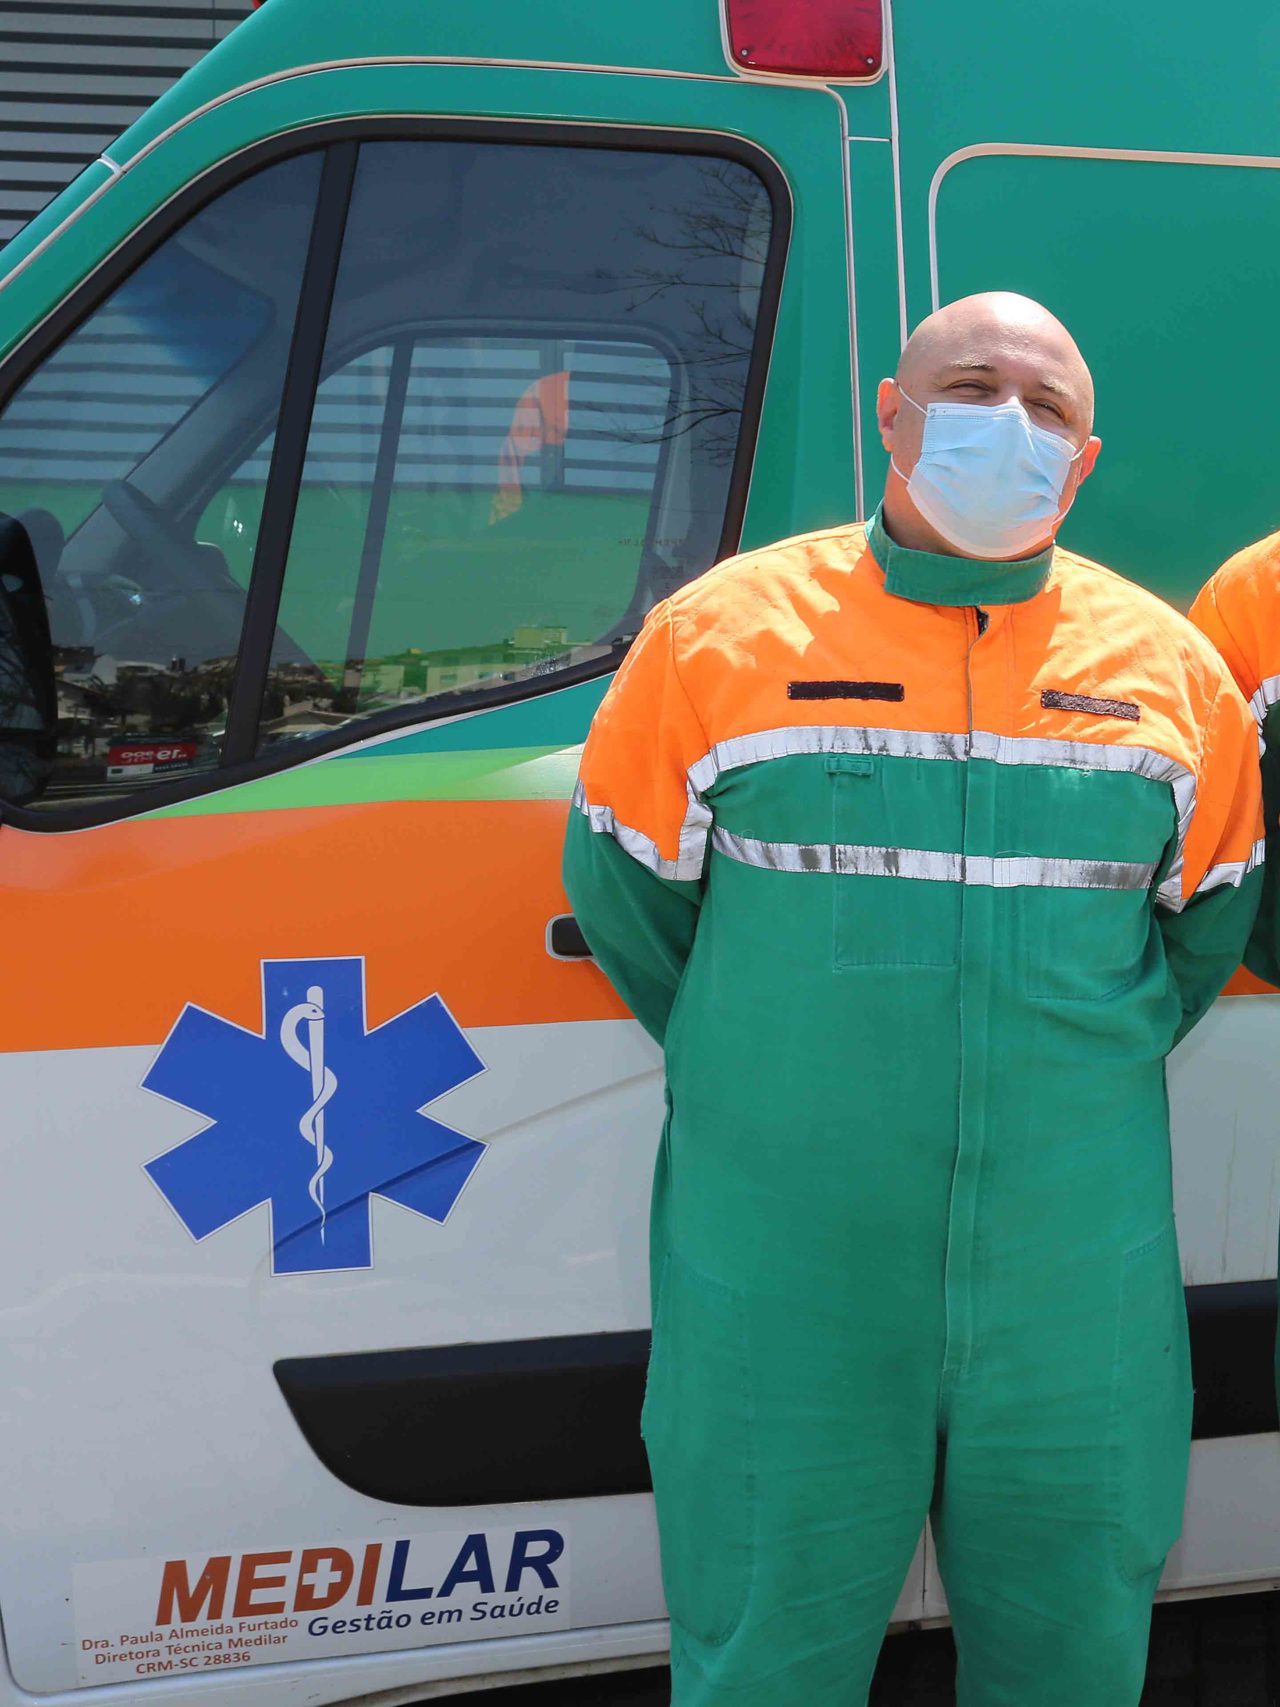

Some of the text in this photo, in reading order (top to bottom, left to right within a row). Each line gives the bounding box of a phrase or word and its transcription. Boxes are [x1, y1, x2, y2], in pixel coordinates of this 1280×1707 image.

[155, 1529, 565, 1626] MEDILAR
[308, 1595, 560, 1636] Gestão em Saúde
[82, 1617, 299, 1651] Dra. Paula Almeida Furtado
[94, 1635, 289, 1665] Diretora Técnica Medilar
[136, 1651, 251, 1674] CRM-SC 28836
